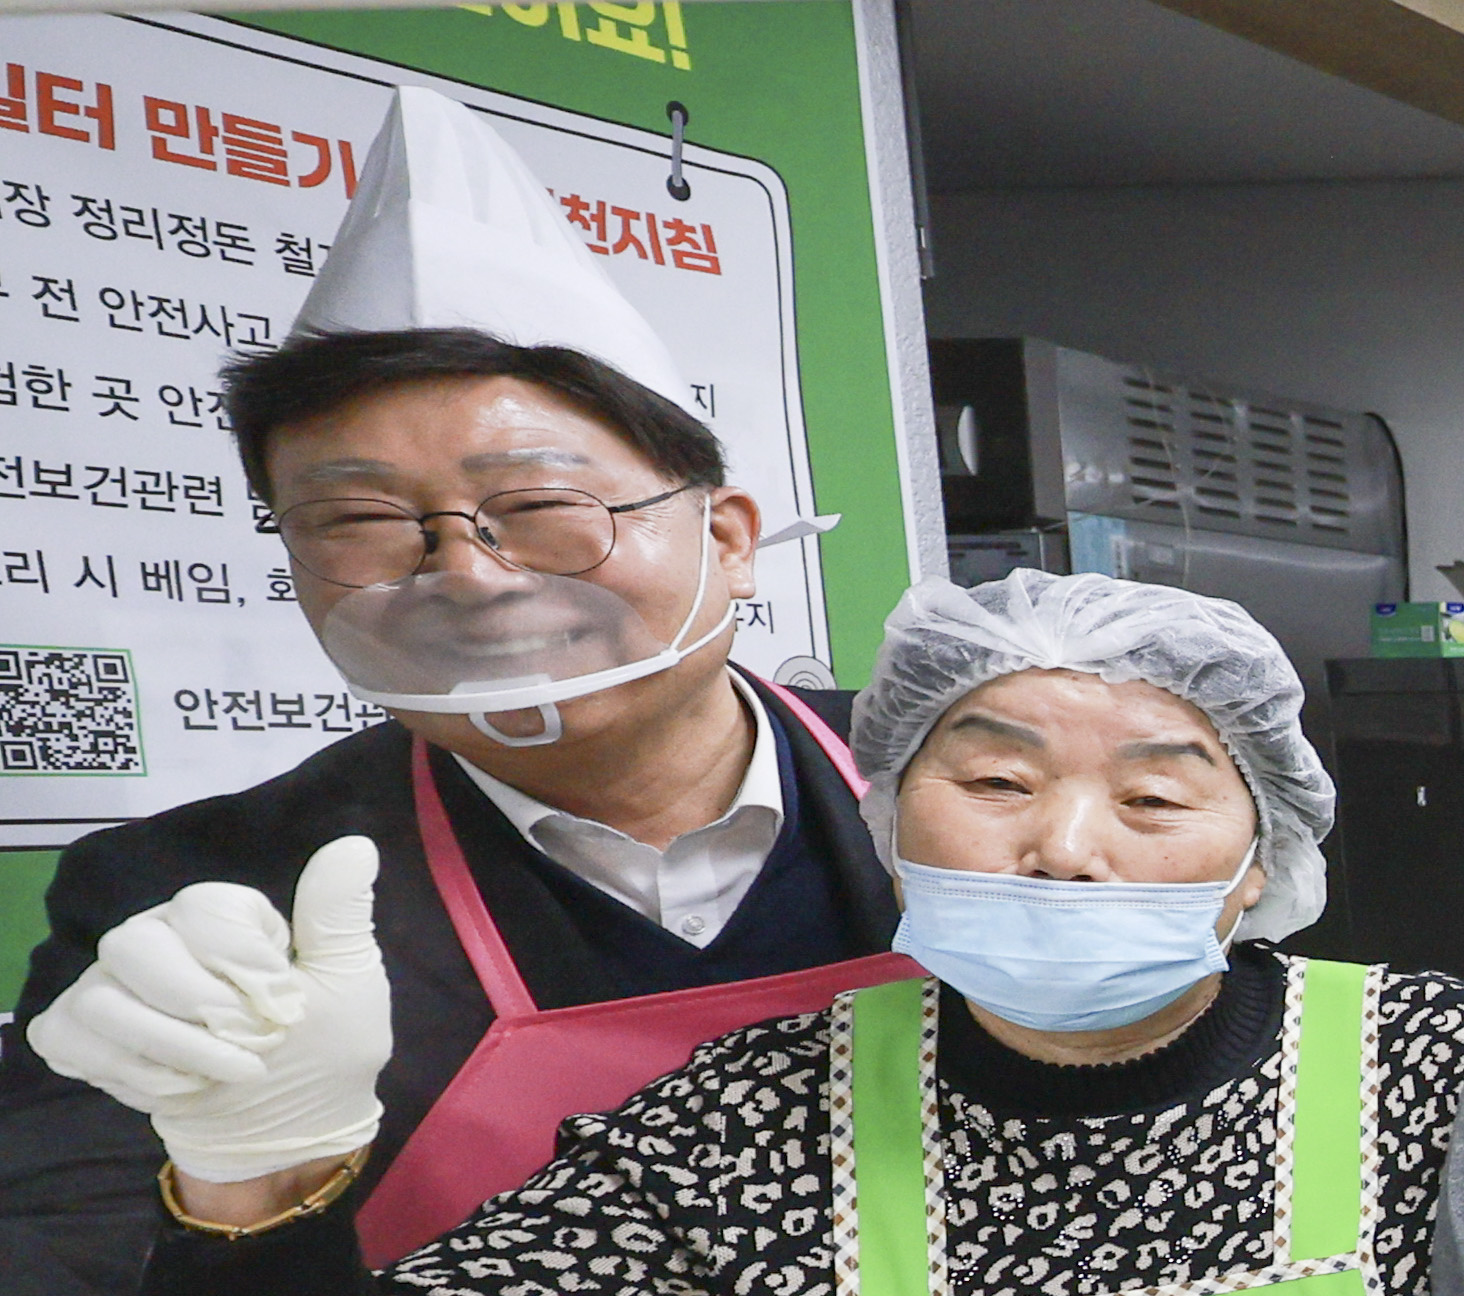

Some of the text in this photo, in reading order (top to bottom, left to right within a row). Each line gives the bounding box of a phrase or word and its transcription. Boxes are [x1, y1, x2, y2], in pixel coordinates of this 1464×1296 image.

[143, 95, 358, 200] 만들기
[545, 188, 722, 276] 천지침
[71, 194, 256, 266] 정리정돈
[98, 286, 278, 350] 안전사고
[92, 375, 140, 421] 곳
[74, 555, 119, 598] 시
[140, 560, 246, 607] 베임,
